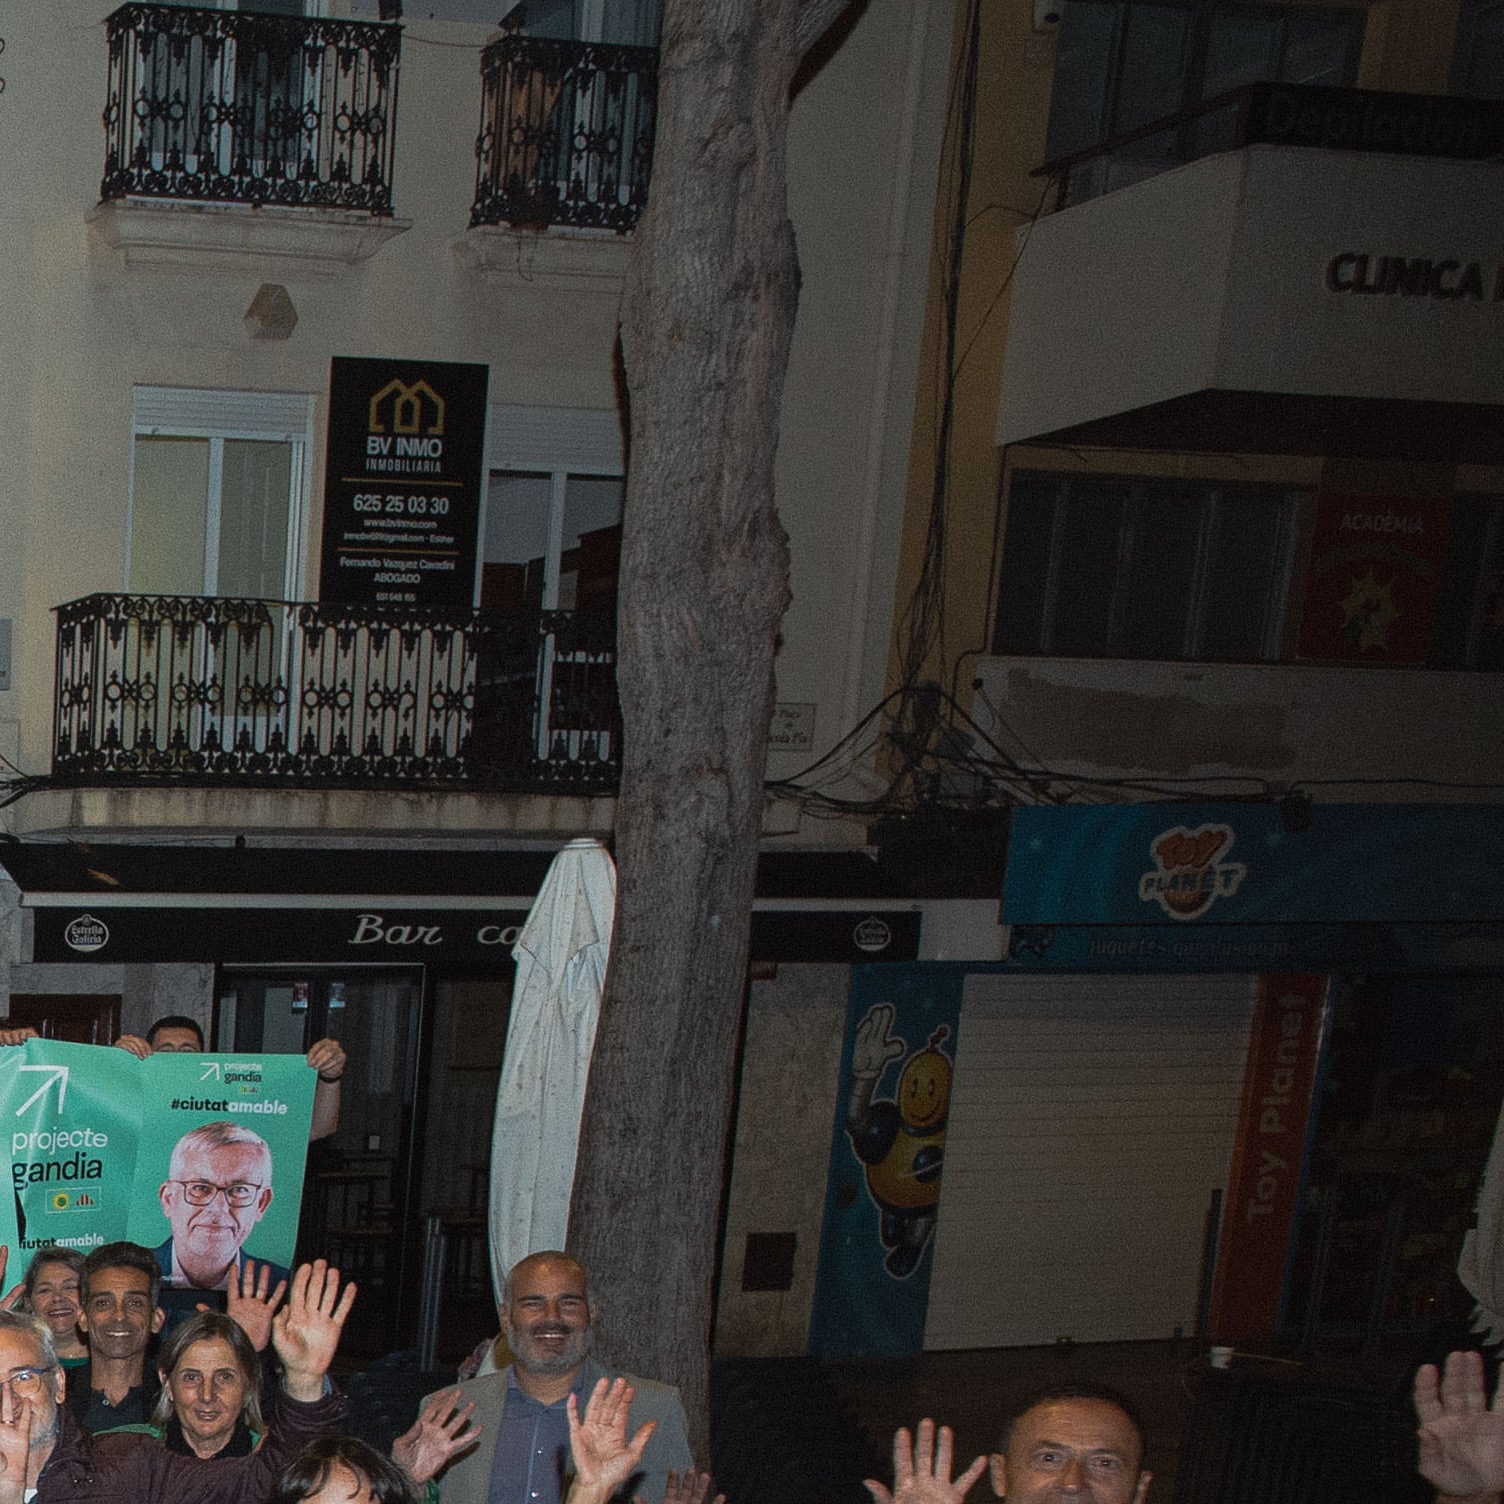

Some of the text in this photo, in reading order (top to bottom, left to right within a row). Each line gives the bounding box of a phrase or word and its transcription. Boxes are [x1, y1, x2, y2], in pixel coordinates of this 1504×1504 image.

[367, 436, 442, 457] BV INMO
[366, 458, 441, 473] INMOBILIARIA
[353, 494, 449, 514] 625 25 03 30
[373, 573, 421, 584] ABOGADO
[71, 925, 104, 935] Estrella
[347, 913, 444, 945] Bar
[1259, 991, 1306, 1135] Planet
[224, 1069, 262, 1083] gandia
[171, 1097, 288, 1115] #ciutatamable
[11, 1126, 109, 1156] projecte
[11, 1152, 102, 1191] gandia
[1247, 1149, 1289, 1224] Toy
[22, 1234, 104, 1250] iutatamable
